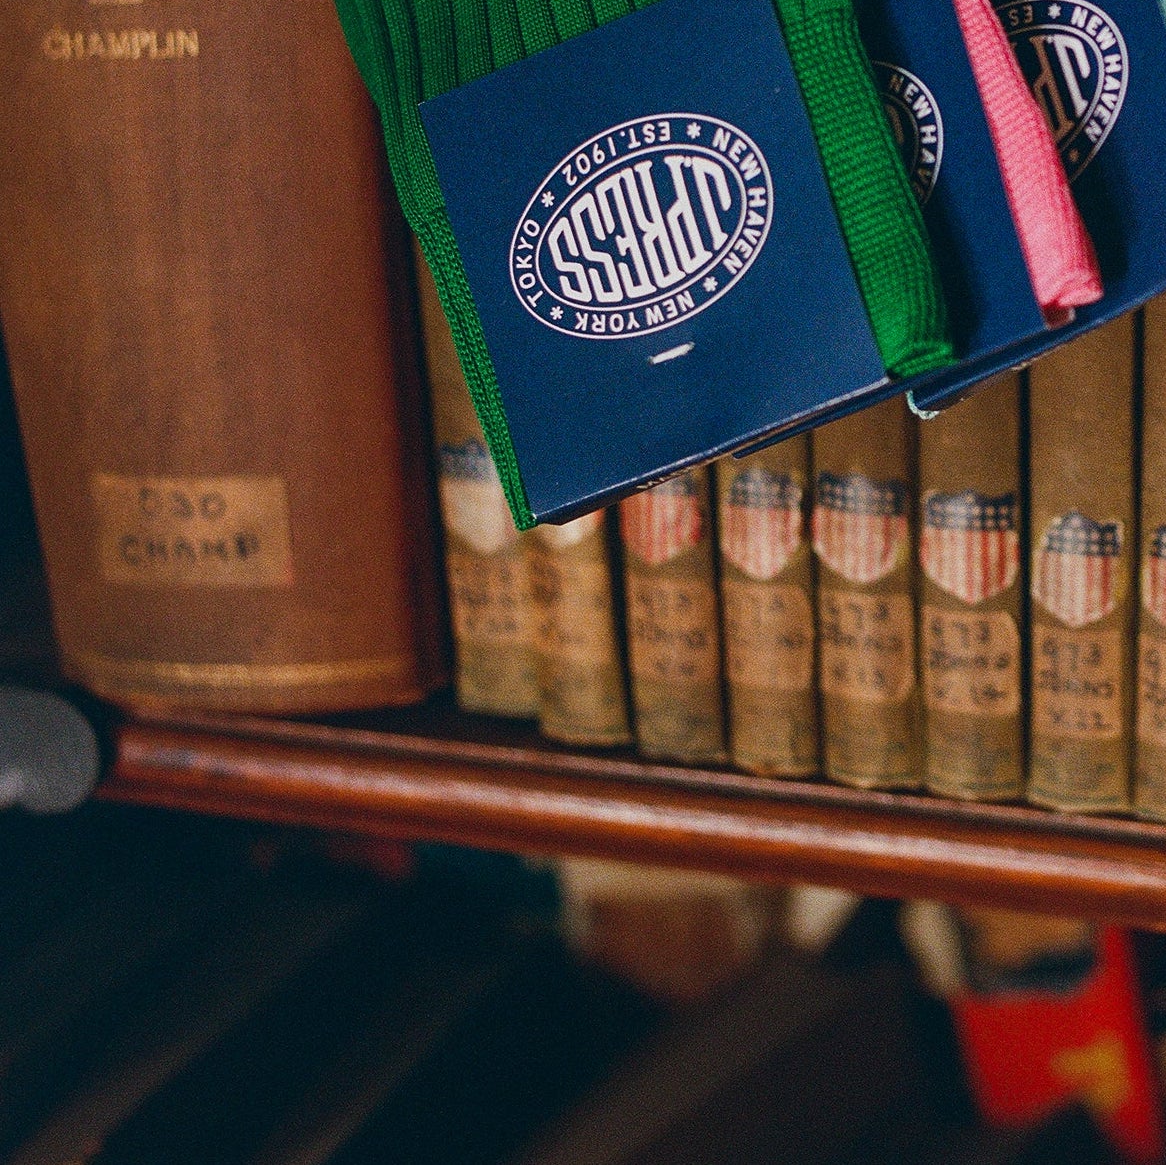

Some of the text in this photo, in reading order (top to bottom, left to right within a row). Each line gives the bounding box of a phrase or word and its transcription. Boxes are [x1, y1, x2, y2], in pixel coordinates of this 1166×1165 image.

[889, 73, 933, 120] NEW
[1070, 5, 1123, 143] NEW HAVEN
[619, 120, 671, 150] EST.
[711, 126, 767, 275] NEW HAVEN
[515, 218, 545, 308] TOKYO
[574, 289, 696, 332] NEW YORK
